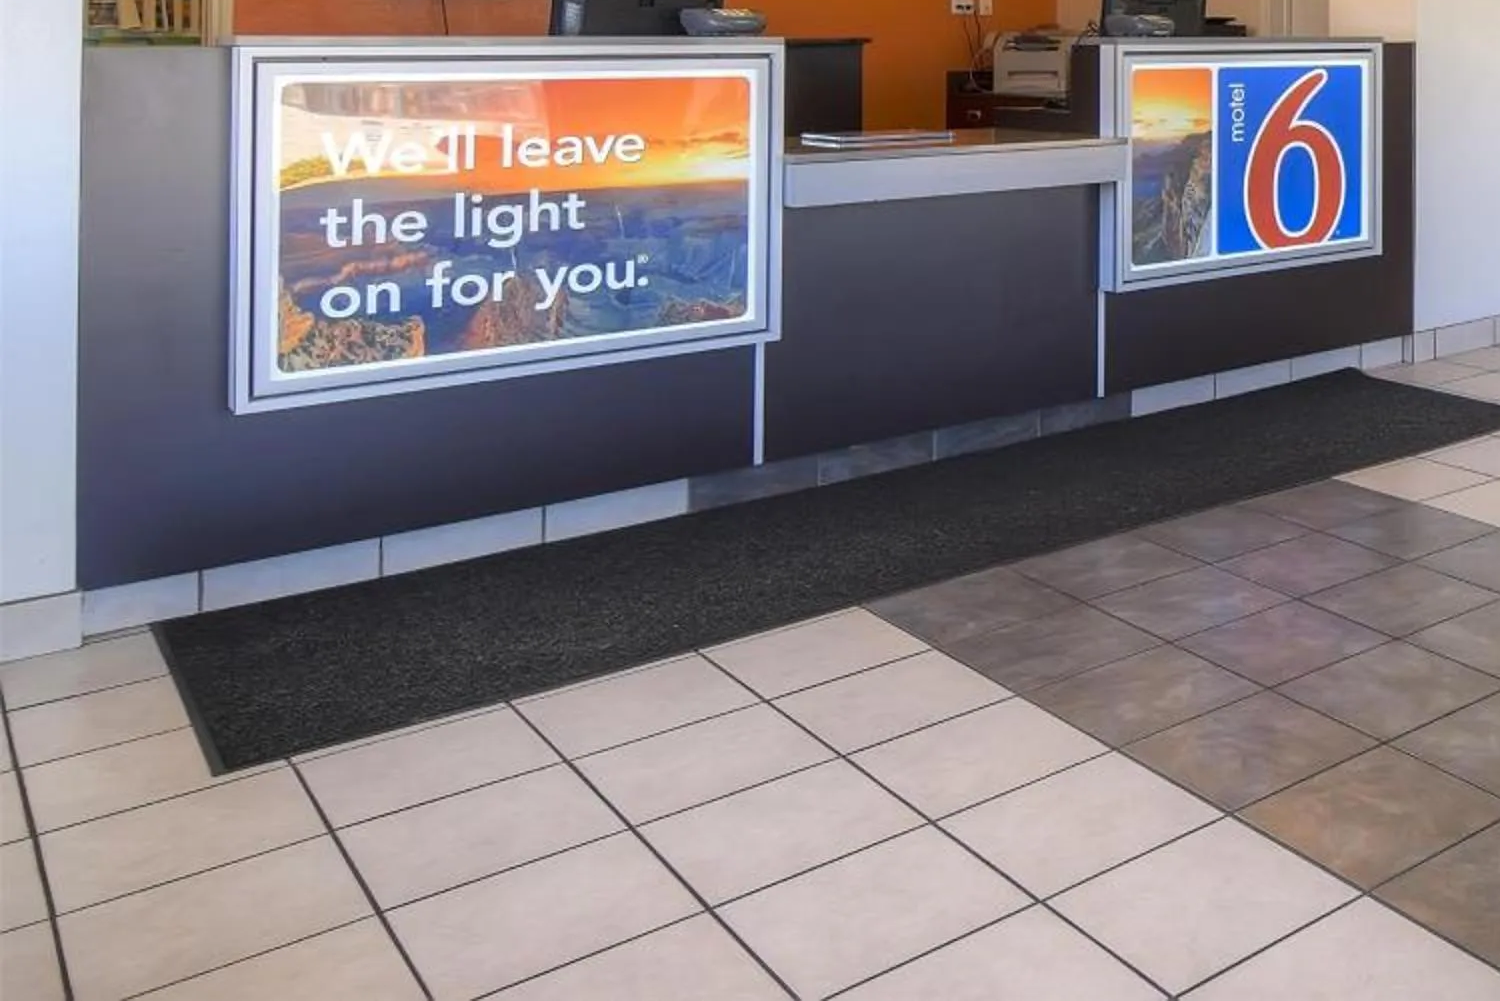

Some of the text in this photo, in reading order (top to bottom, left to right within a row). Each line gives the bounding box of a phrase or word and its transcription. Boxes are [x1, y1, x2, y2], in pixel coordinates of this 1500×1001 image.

[320, 124, 646, 176] We'll leave
[1228, 68, 1346, 250] motel 6
[319, 188, 586, 249] the light
[319, 279, 400, 318] on
[425, 261, 516, 309] for
